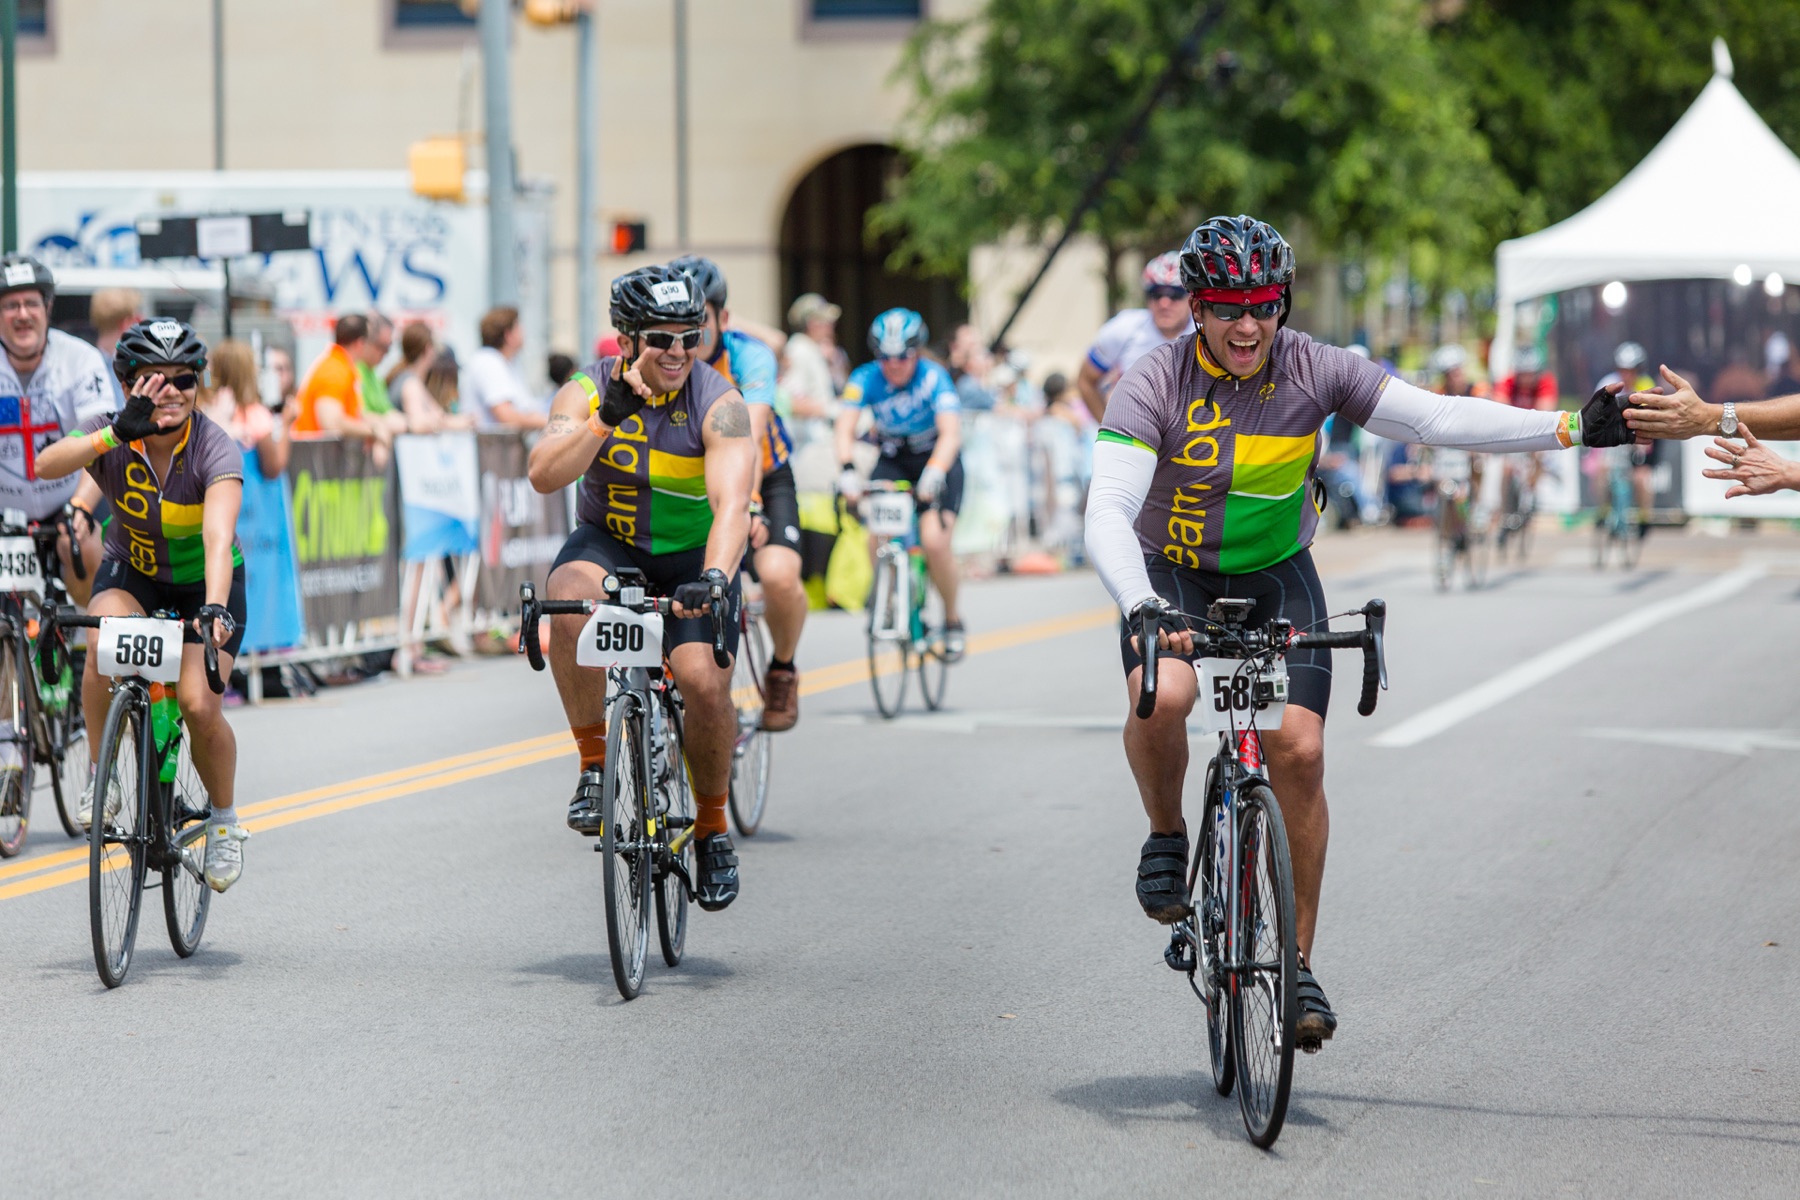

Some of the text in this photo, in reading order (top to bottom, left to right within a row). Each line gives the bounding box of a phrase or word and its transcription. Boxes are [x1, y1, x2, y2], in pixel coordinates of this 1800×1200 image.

[599, 413, 648, 474] bp
[1170, 398, 1231, 467] bp
[116, 461, 158, 520] bp
[115, 634, 164, 668] 589
[596, 621, 644, 652] 590
[1212, 675, 1270, 713] 58
